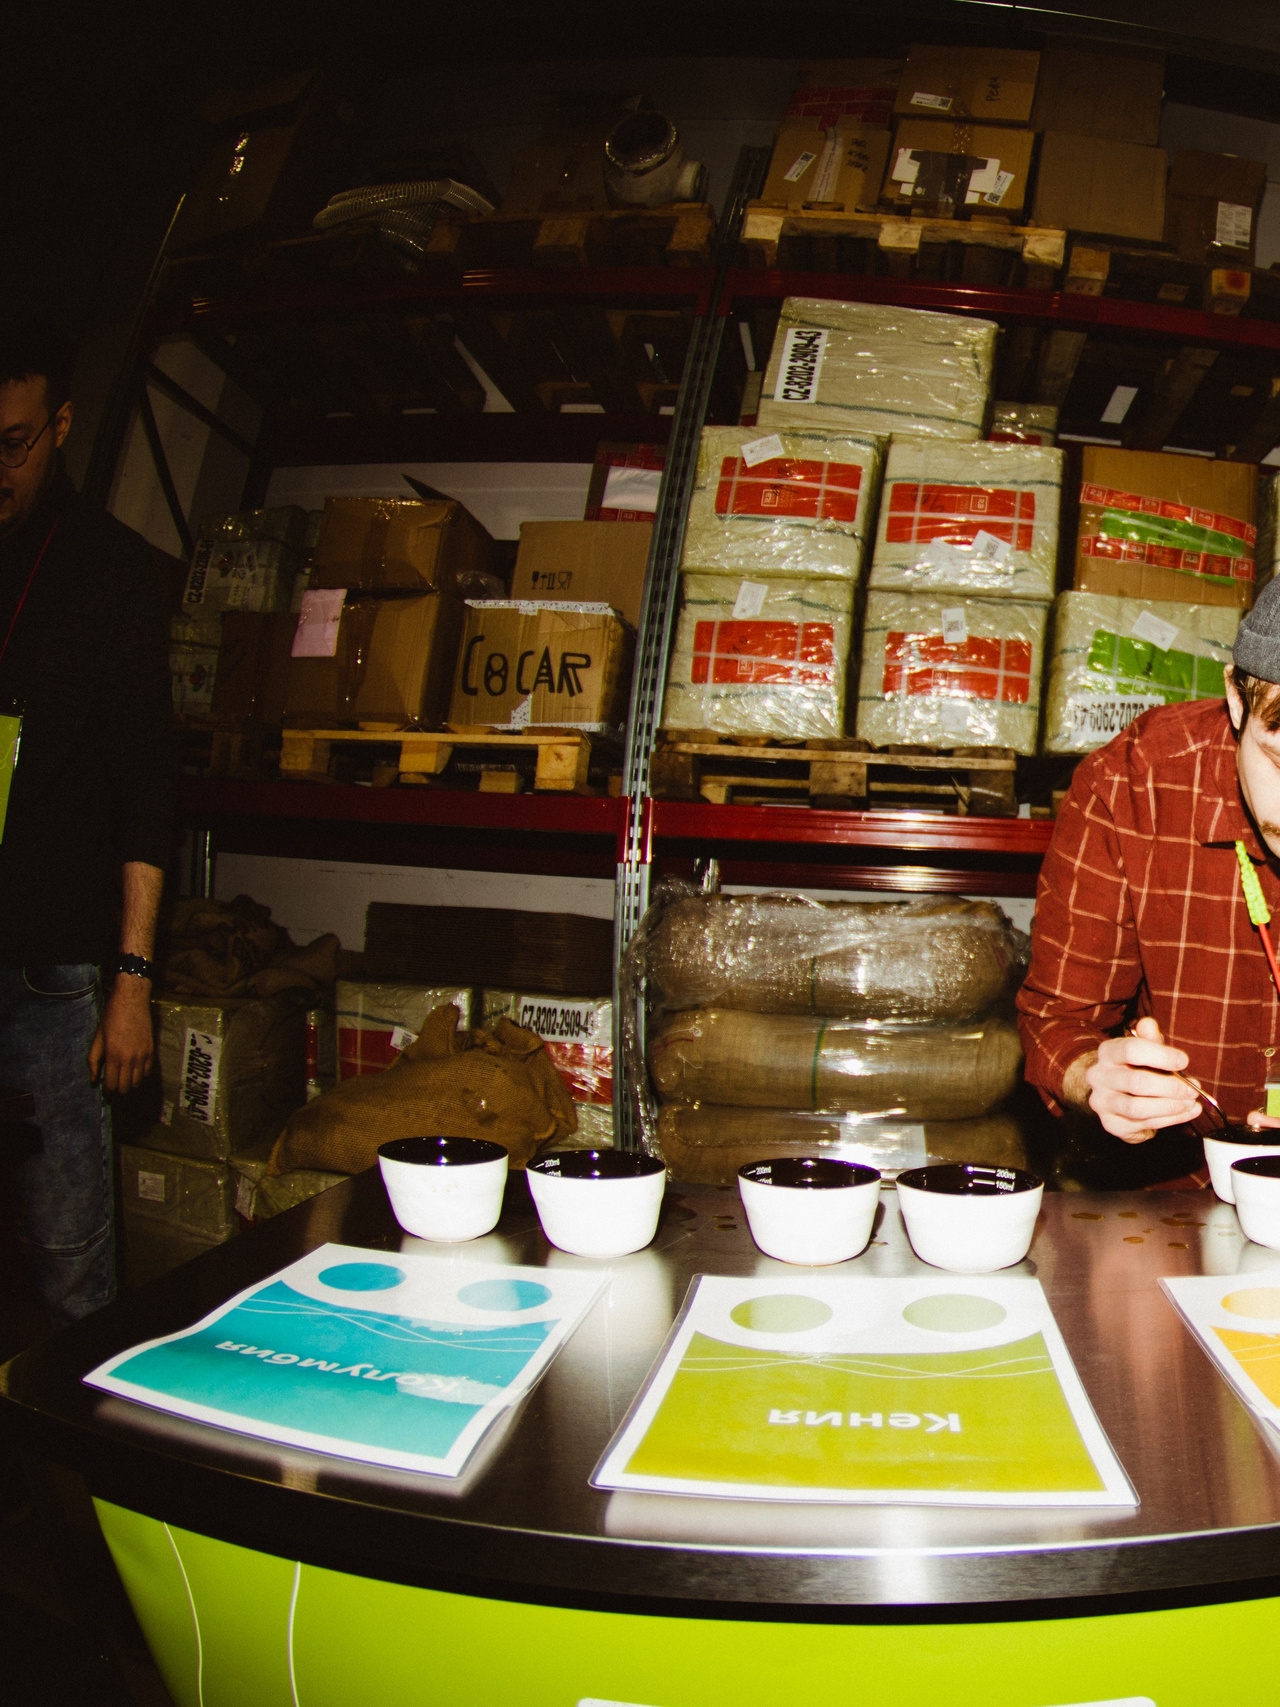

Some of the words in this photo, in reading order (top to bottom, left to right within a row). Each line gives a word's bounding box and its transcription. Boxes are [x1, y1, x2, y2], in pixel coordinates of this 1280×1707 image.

[781, 329, 823, 401] CZ-8202-2909-43
[1073, 701, 1161, 734] -202-2909-43
[995, 1168, 1016, 1180] 200ml
[995, 1180, 1016, 1192] 150ml
[214, 1339, 460, 1395] Колумбия
[767, 1407, 963, 1434] Кения
